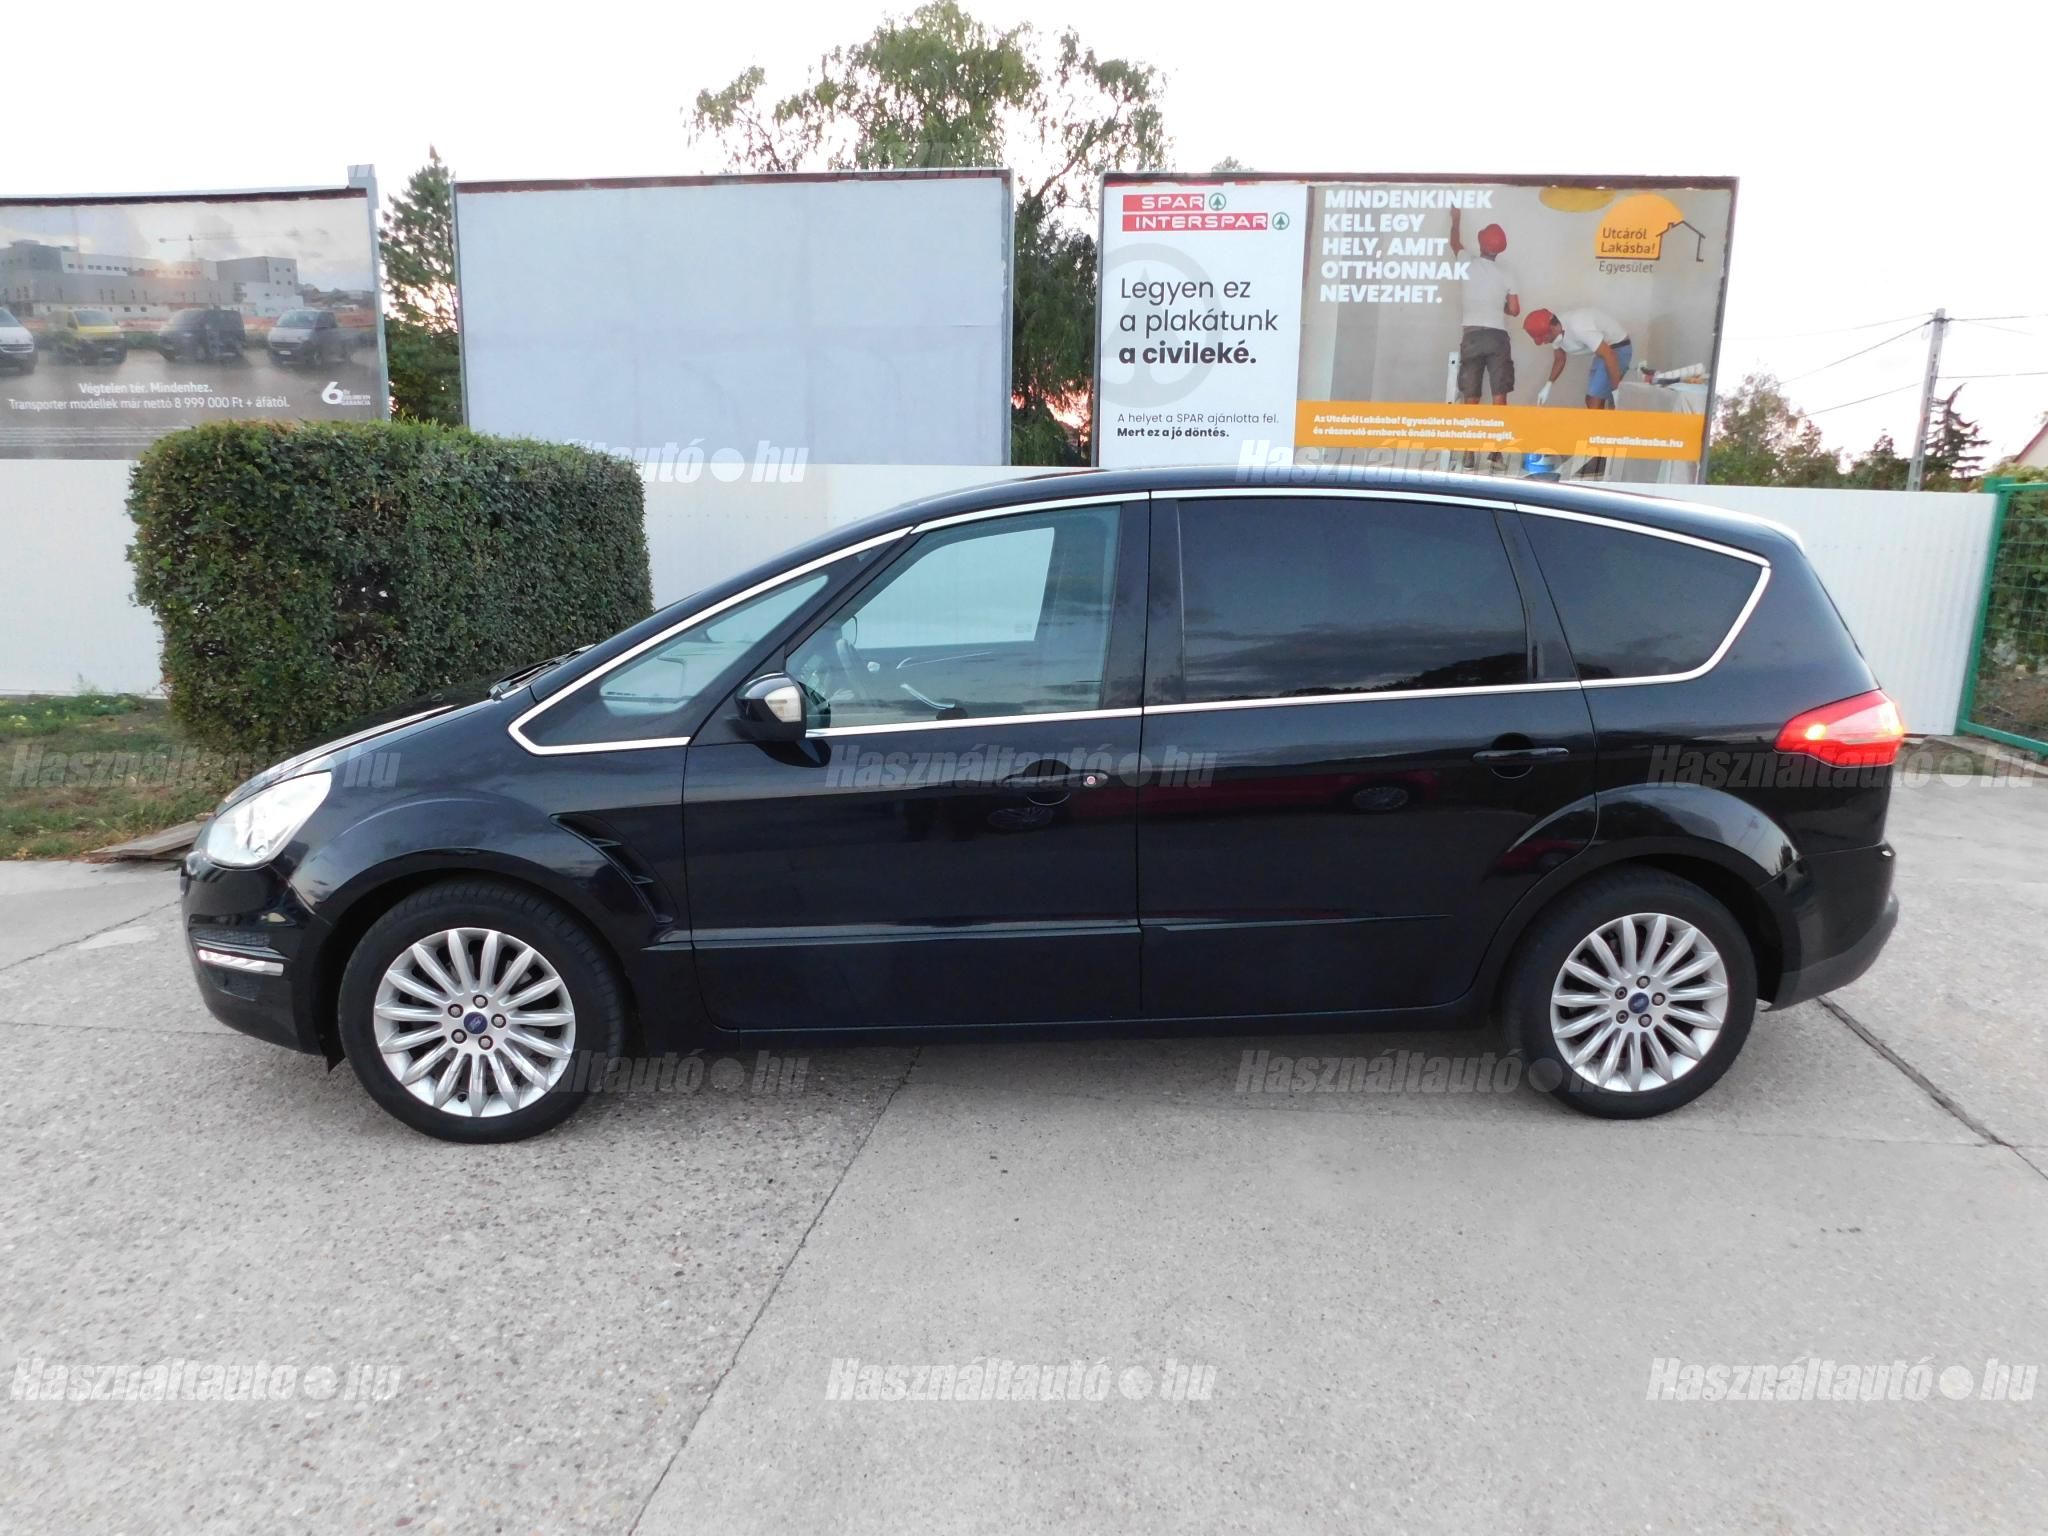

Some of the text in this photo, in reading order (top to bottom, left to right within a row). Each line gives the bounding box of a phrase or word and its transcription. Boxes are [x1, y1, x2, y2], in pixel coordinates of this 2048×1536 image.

[1141, 196, 1204, 209] SPAR
[1325, 190, 1493, 209] MINDENKINEK
[1135, 215, 1267, 229] INTERSPAR
[1324, 213, 1425, 233] KELL EGY
[1602, 227, 1647, 240] Utcáról
[1322, 237, 1448, 258] HELY, AMIT
[1600, 241, 1656, 254] Lakásba!
[1321, 261, 1471, 281] OTTHONNAK
[1121, 277, 1251, 306] Legyen ez
[1319, 284, 1443, 303] NEVEZHET.
[1119, 308, 1279, 339] a plakátunk
[1118, 339, 1257, 365] a civileké.
[78, 382, 128, 396] Végtelen
[151, 382, 213, 393] Mindenhez.
[321, 381, 344, 405] 6
[8, 398, 67, 411] Transporter
[70, 398, 119, 409] modellek
[174, 397, 182, 409] 8
[184, 397, 205, 408] 999
[207, 397, 230, 408] 000
[232, 397, 244, 408] Ft
[1117, 412, 1279, 425] A helyet a SPAR ajánlotta fel.
[1117, 426, 1230, 440] Mert ez a jó döntés.
